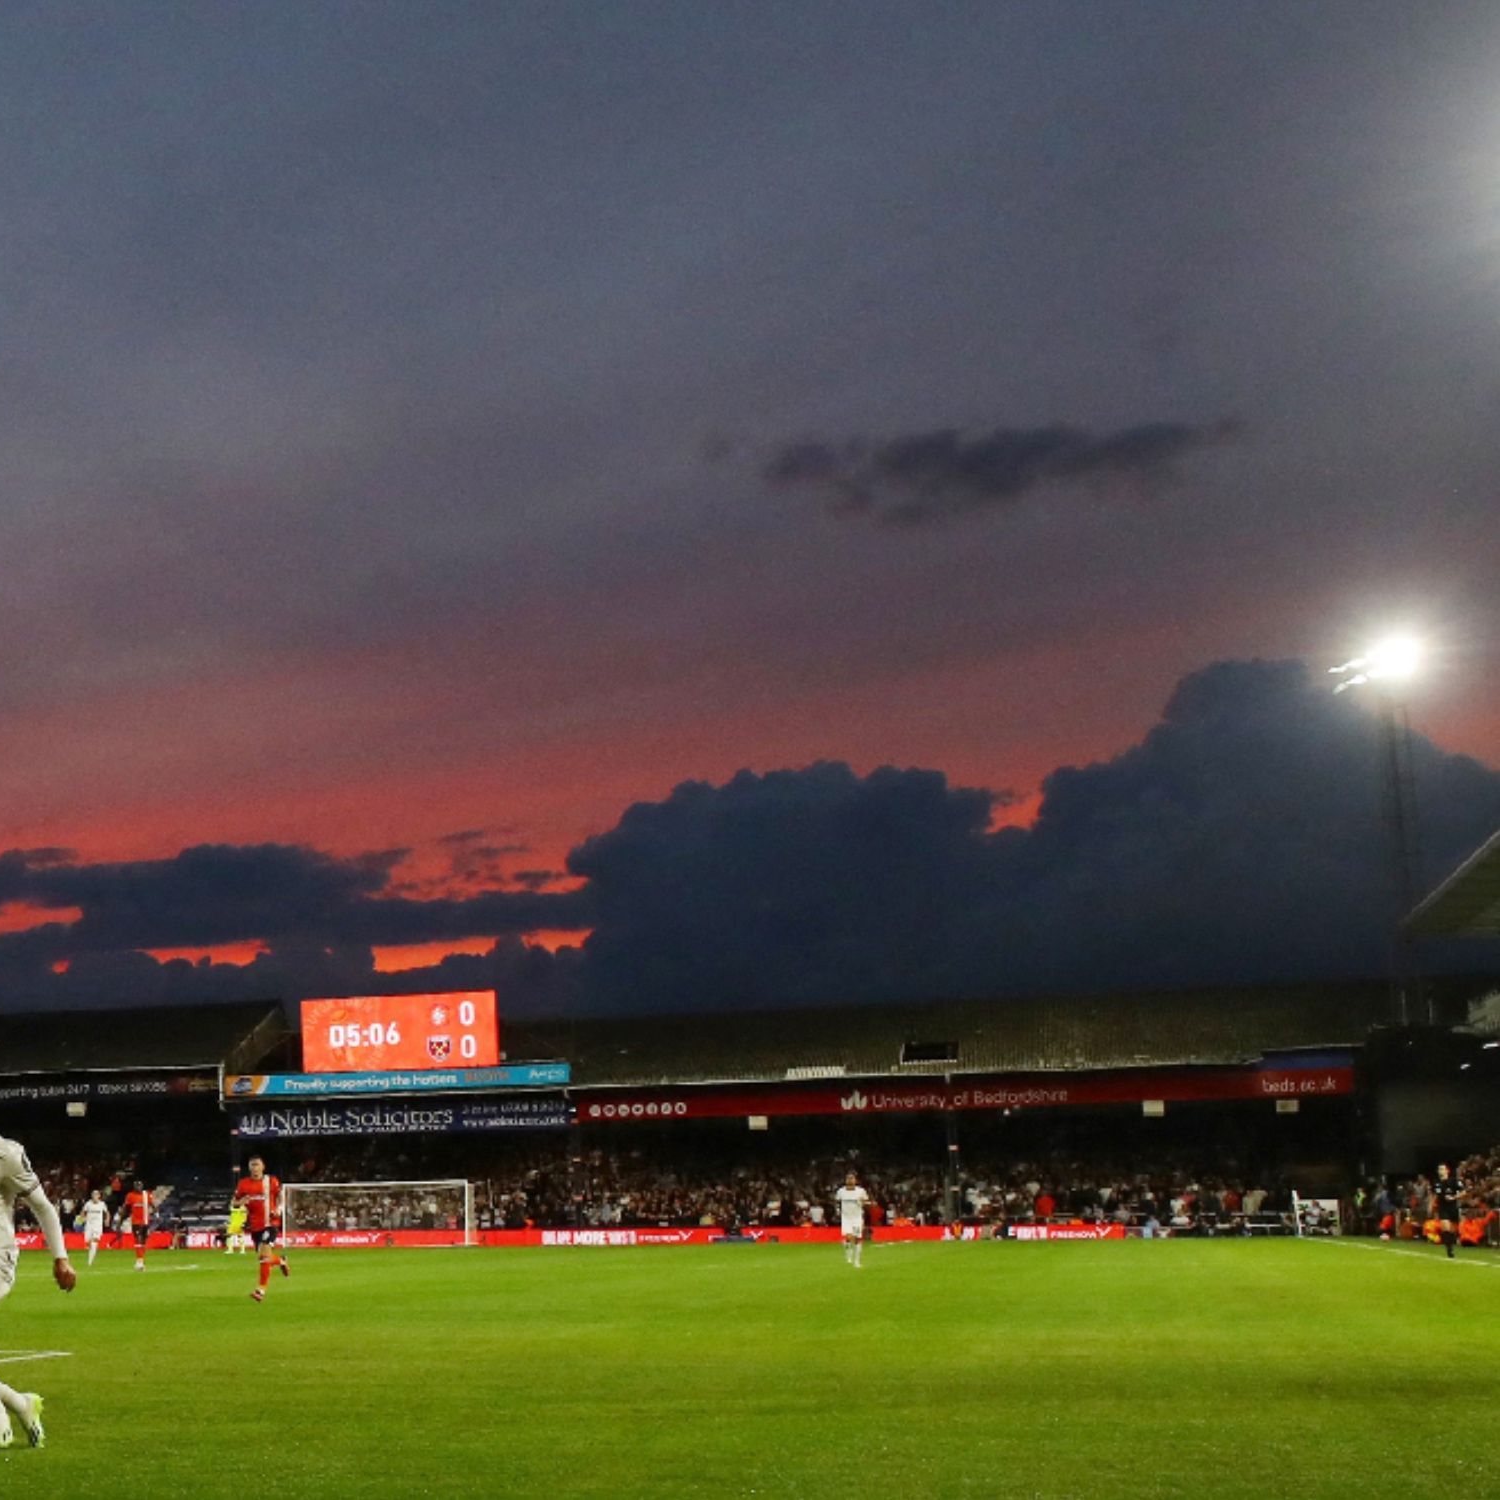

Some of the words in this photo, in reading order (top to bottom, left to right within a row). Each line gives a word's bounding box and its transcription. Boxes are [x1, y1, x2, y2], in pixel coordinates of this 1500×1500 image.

[459, 1001, 475, 1026] 0
[329, 1022, 400, 1048] 05:06
[460, 1034, 476, 1059] 0
[66, 1083, 90, 1095] 24/7
[284, 1078, 328, 1090] Proudly
[329, 1075, 390, 1089] supporting
[392, 1074, 411, 1086] the
[872, 1093, 946, 1109] University
[953, 1091, 970, 1105] of
[973, 1088, 1068, 1104] Bedfordshire
[269, 1109, 342, 1131] Noble
[345, 1105, 453, 1127] Solicitors
[1050, 1231, 1097, 1239] FREENOW
